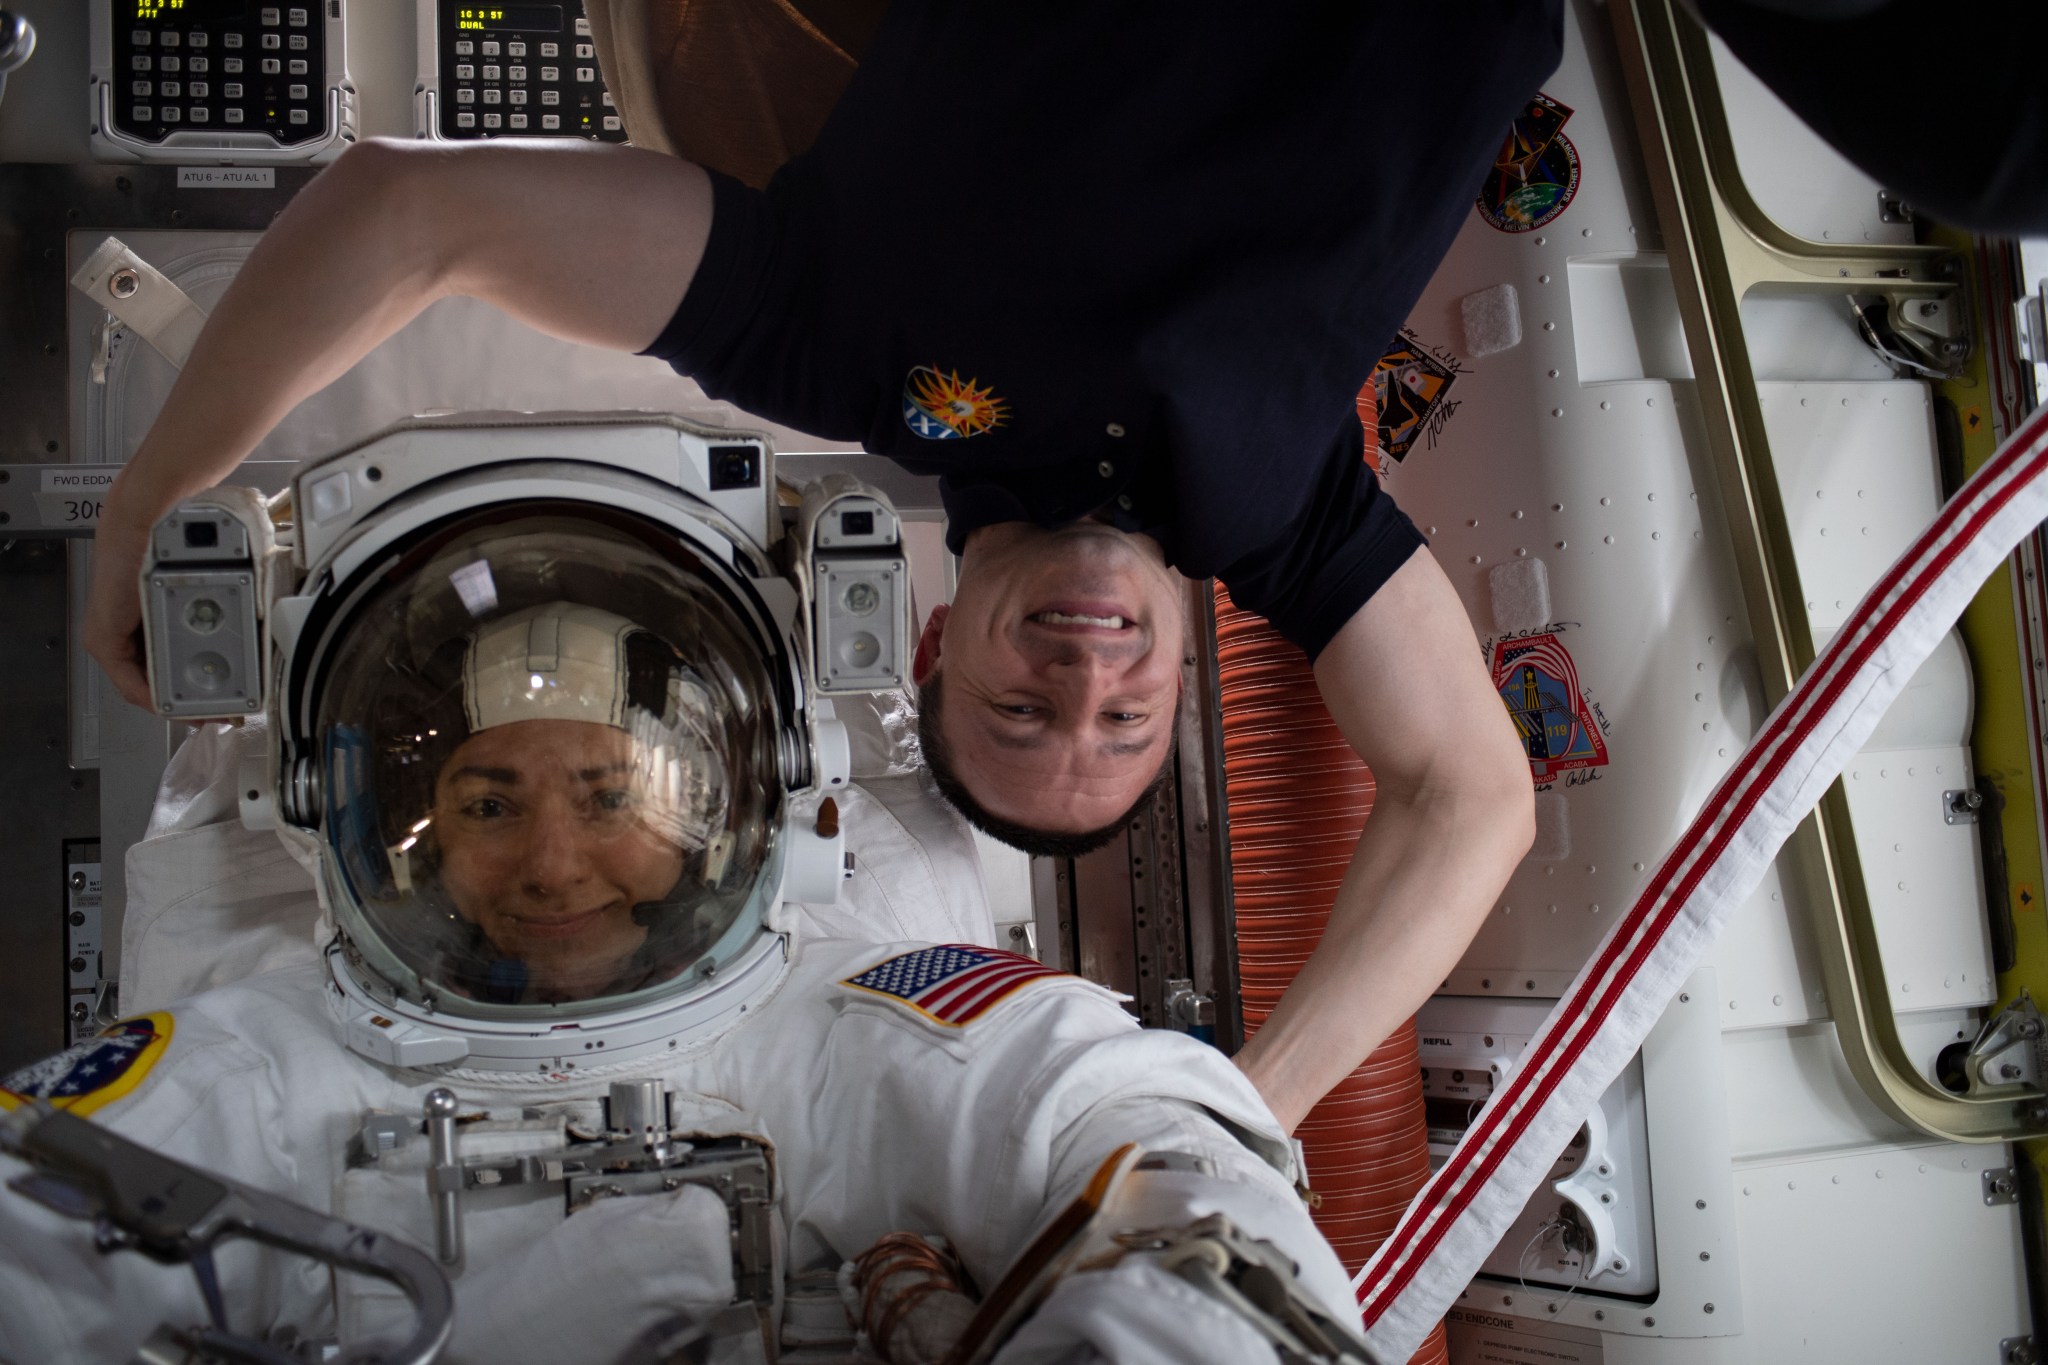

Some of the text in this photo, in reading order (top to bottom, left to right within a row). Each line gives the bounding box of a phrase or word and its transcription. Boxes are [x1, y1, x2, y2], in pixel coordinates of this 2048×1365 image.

[158, 0, 165, 8] 3
[138, 9, 157, 18] PTT
[460, 10, 473, 18] 1G
[478, 10, 485, 19] 3
[460, 21, 485, 29] DUAL
[1535, 94, 1557, 108] 29
[1556, 134, 1578, 165] WILMORE
[244, 174, 260, 182] A/L
[1564, 168, 1579, 203] SATCHER
[1478, 201, 1502, 229] FOREMAN
[1533, 204, 1565, 228] BRESNIK
[1504, 224, 1530, 232] MELVIN
[1424, 358, 1446, 376] NYBERG
[1417, 393, 1442, 430] CHAMITOFF
[54, 476, 113, 485] FWD EDDA
[1502, 635, 1554, 651] ARCHAMBAULT
[1494, 660, 1502, 687] ILLIPS
[1547, 725, 1568, 737] 119
[1580, 711, 1602, 750] ANTONELLI
[1564, 760, 1589, 769] ACABA
[1533, 774, 1557, 784] AKATA
[1423, 1038, 1452, 1046] REFILL
[1446, 1310, 1514, 1330] BD ENDCONE
[1483, 1340, 1507, 1350] DEPRESS
[1508, 1344, 1523, 1352] PUMP
[1524, 1348, 1557, 1359] ELECTRONIC
[1558, 1353, 1580, 1362] SWITCH
